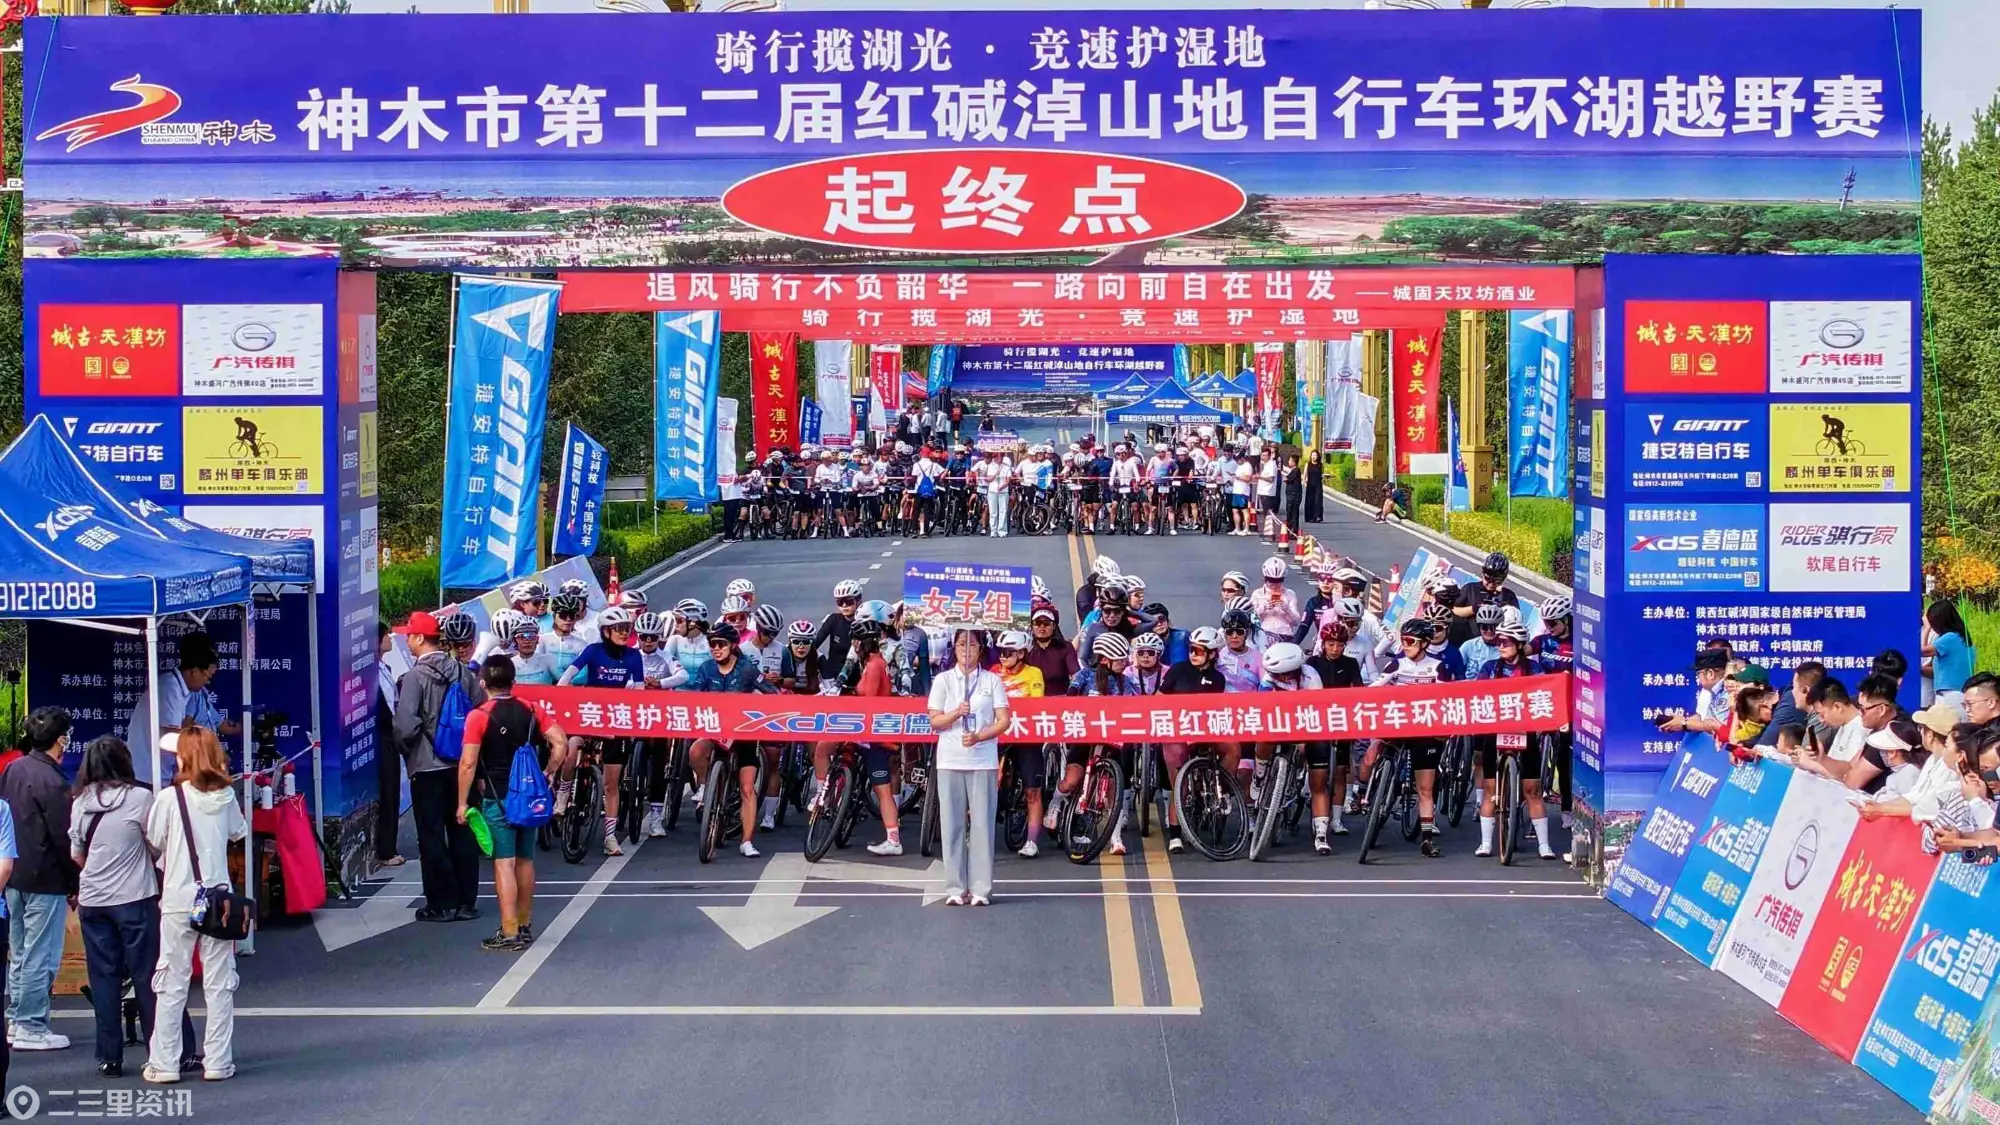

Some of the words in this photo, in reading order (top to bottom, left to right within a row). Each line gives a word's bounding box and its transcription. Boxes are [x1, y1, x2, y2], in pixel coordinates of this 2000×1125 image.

[297, 75, 1885, 152] 神木市第十二届红碱淖山地自行车环湖越野赛
[143, 124, 196, 135] SHENMU
[202, 120, 276, 146] 神木
[823, 166, 1152, 237] 起终点
[646, 271, 968, 301] 追风骑行不负韶华
[1012, 270, 1337, 302] 一路向前自在出发
[213, 356, 296, 369] 广汽传祺
[1800, 353, 1884, 366] 广汽传祺
[87, 422, 164, 434] GIANT
[684, 348, 707, 497] GIANT
[1536, 345, 1561, 497] GIANT
[1672, 419, 1751, 432] GIANT
[1642, 442, 1750, 460] 捷安特自行车
[462, 382, 496, 556] 捷安特自行车
[487, 355, 532, 580] GIANT
[1629, 509, 1697, 521] 国家级高新技术企业
[1701, 528, 1759, 551] 喜德盛
[1780, 525, 1828, 536] RIDER
[1781, 536, 1822, 546] PLUS
[1806, 556, 1881, 573] 软尾自行车
[920, 586, 1014, 624] 女子组
[1696, 623, 1792, 636] 神木市教育和体育局
[871, 712, 936, 736] 喜德
[1502, 734, 1522, 746] 521
